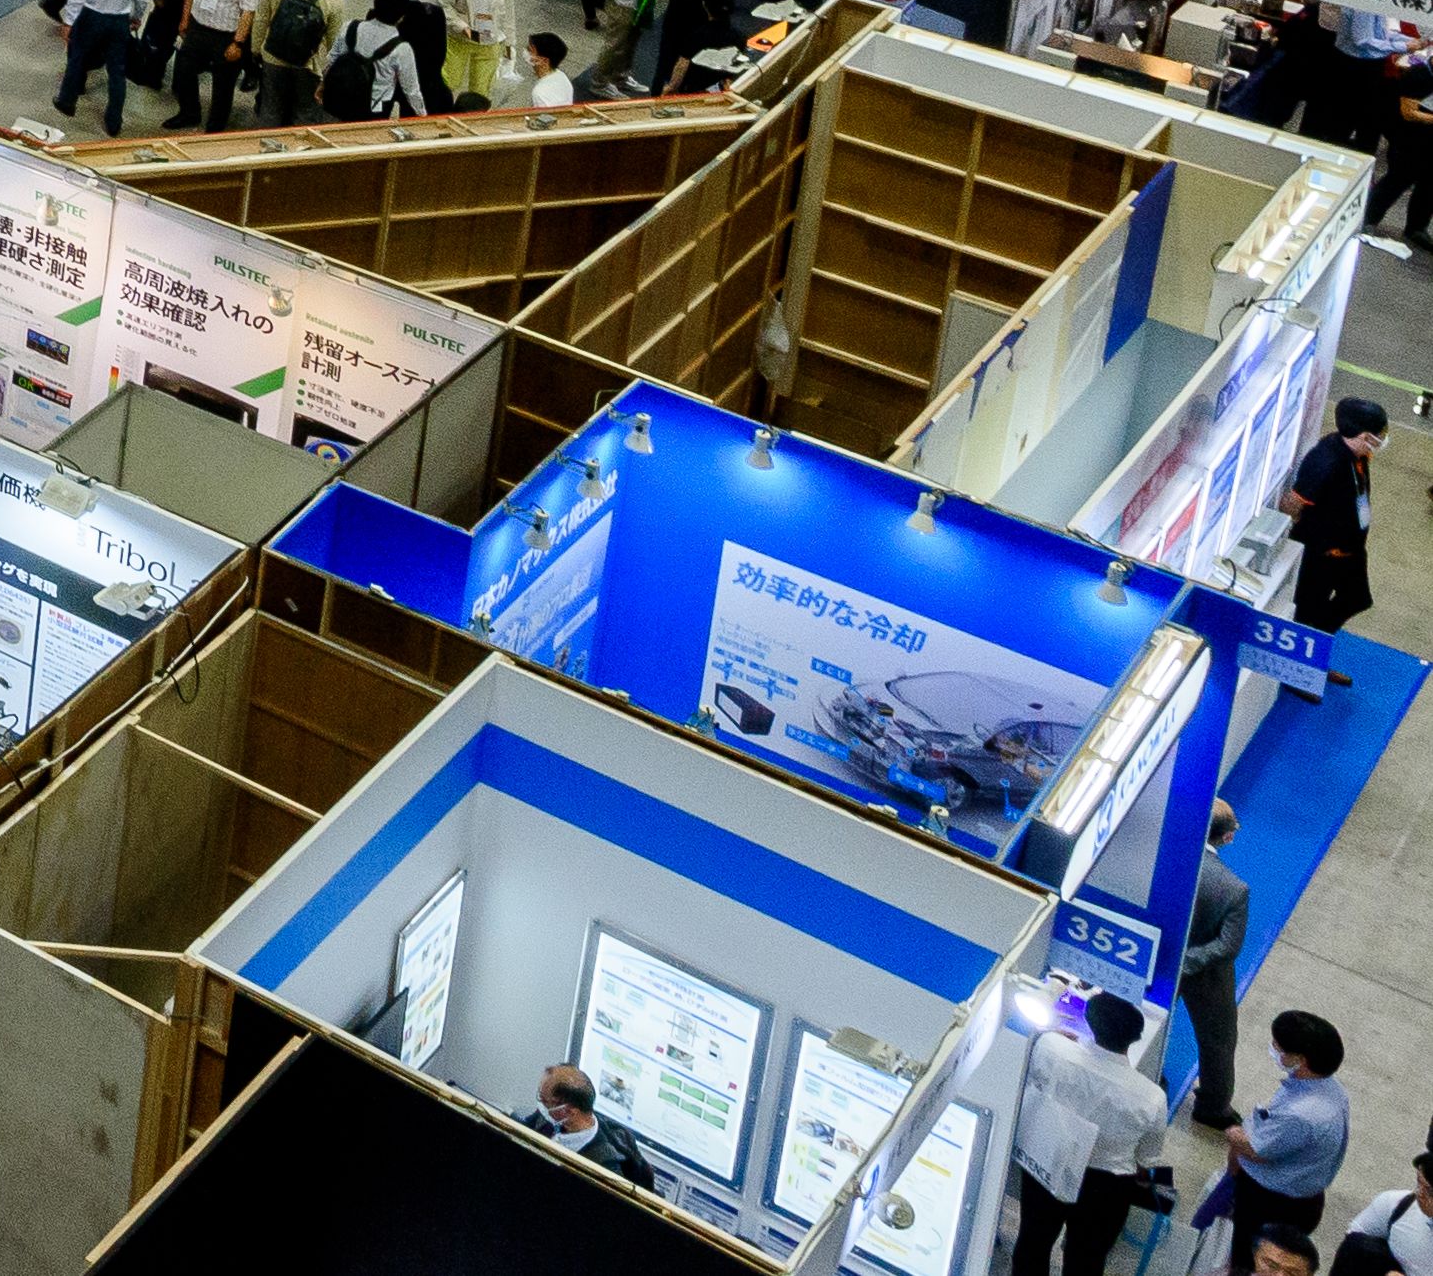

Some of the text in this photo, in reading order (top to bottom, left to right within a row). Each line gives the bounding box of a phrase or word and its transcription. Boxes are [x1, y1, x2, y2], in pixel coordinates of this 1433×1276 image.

[213, 254, 272, 288] PULSTEC
[120, 283, 208, 334] 効果確認
[124, 258, 275, 336] 高周波焼入れの
[125, 311, 184, 341] 高速エリア計測
[403, 322, 467, 357] PULSTEC
[17, 374, 36, 393] OK
[301, 350, 342, 384] 計測
[305, 400, 358, 431] サブゼロ処理
[730, 558, 929, 655] 効率的な冷却
[1253, 619, 1316, 660] 351
[814, 659, 847, 682] ECU
[1065, 915, 1139, 968] 352
